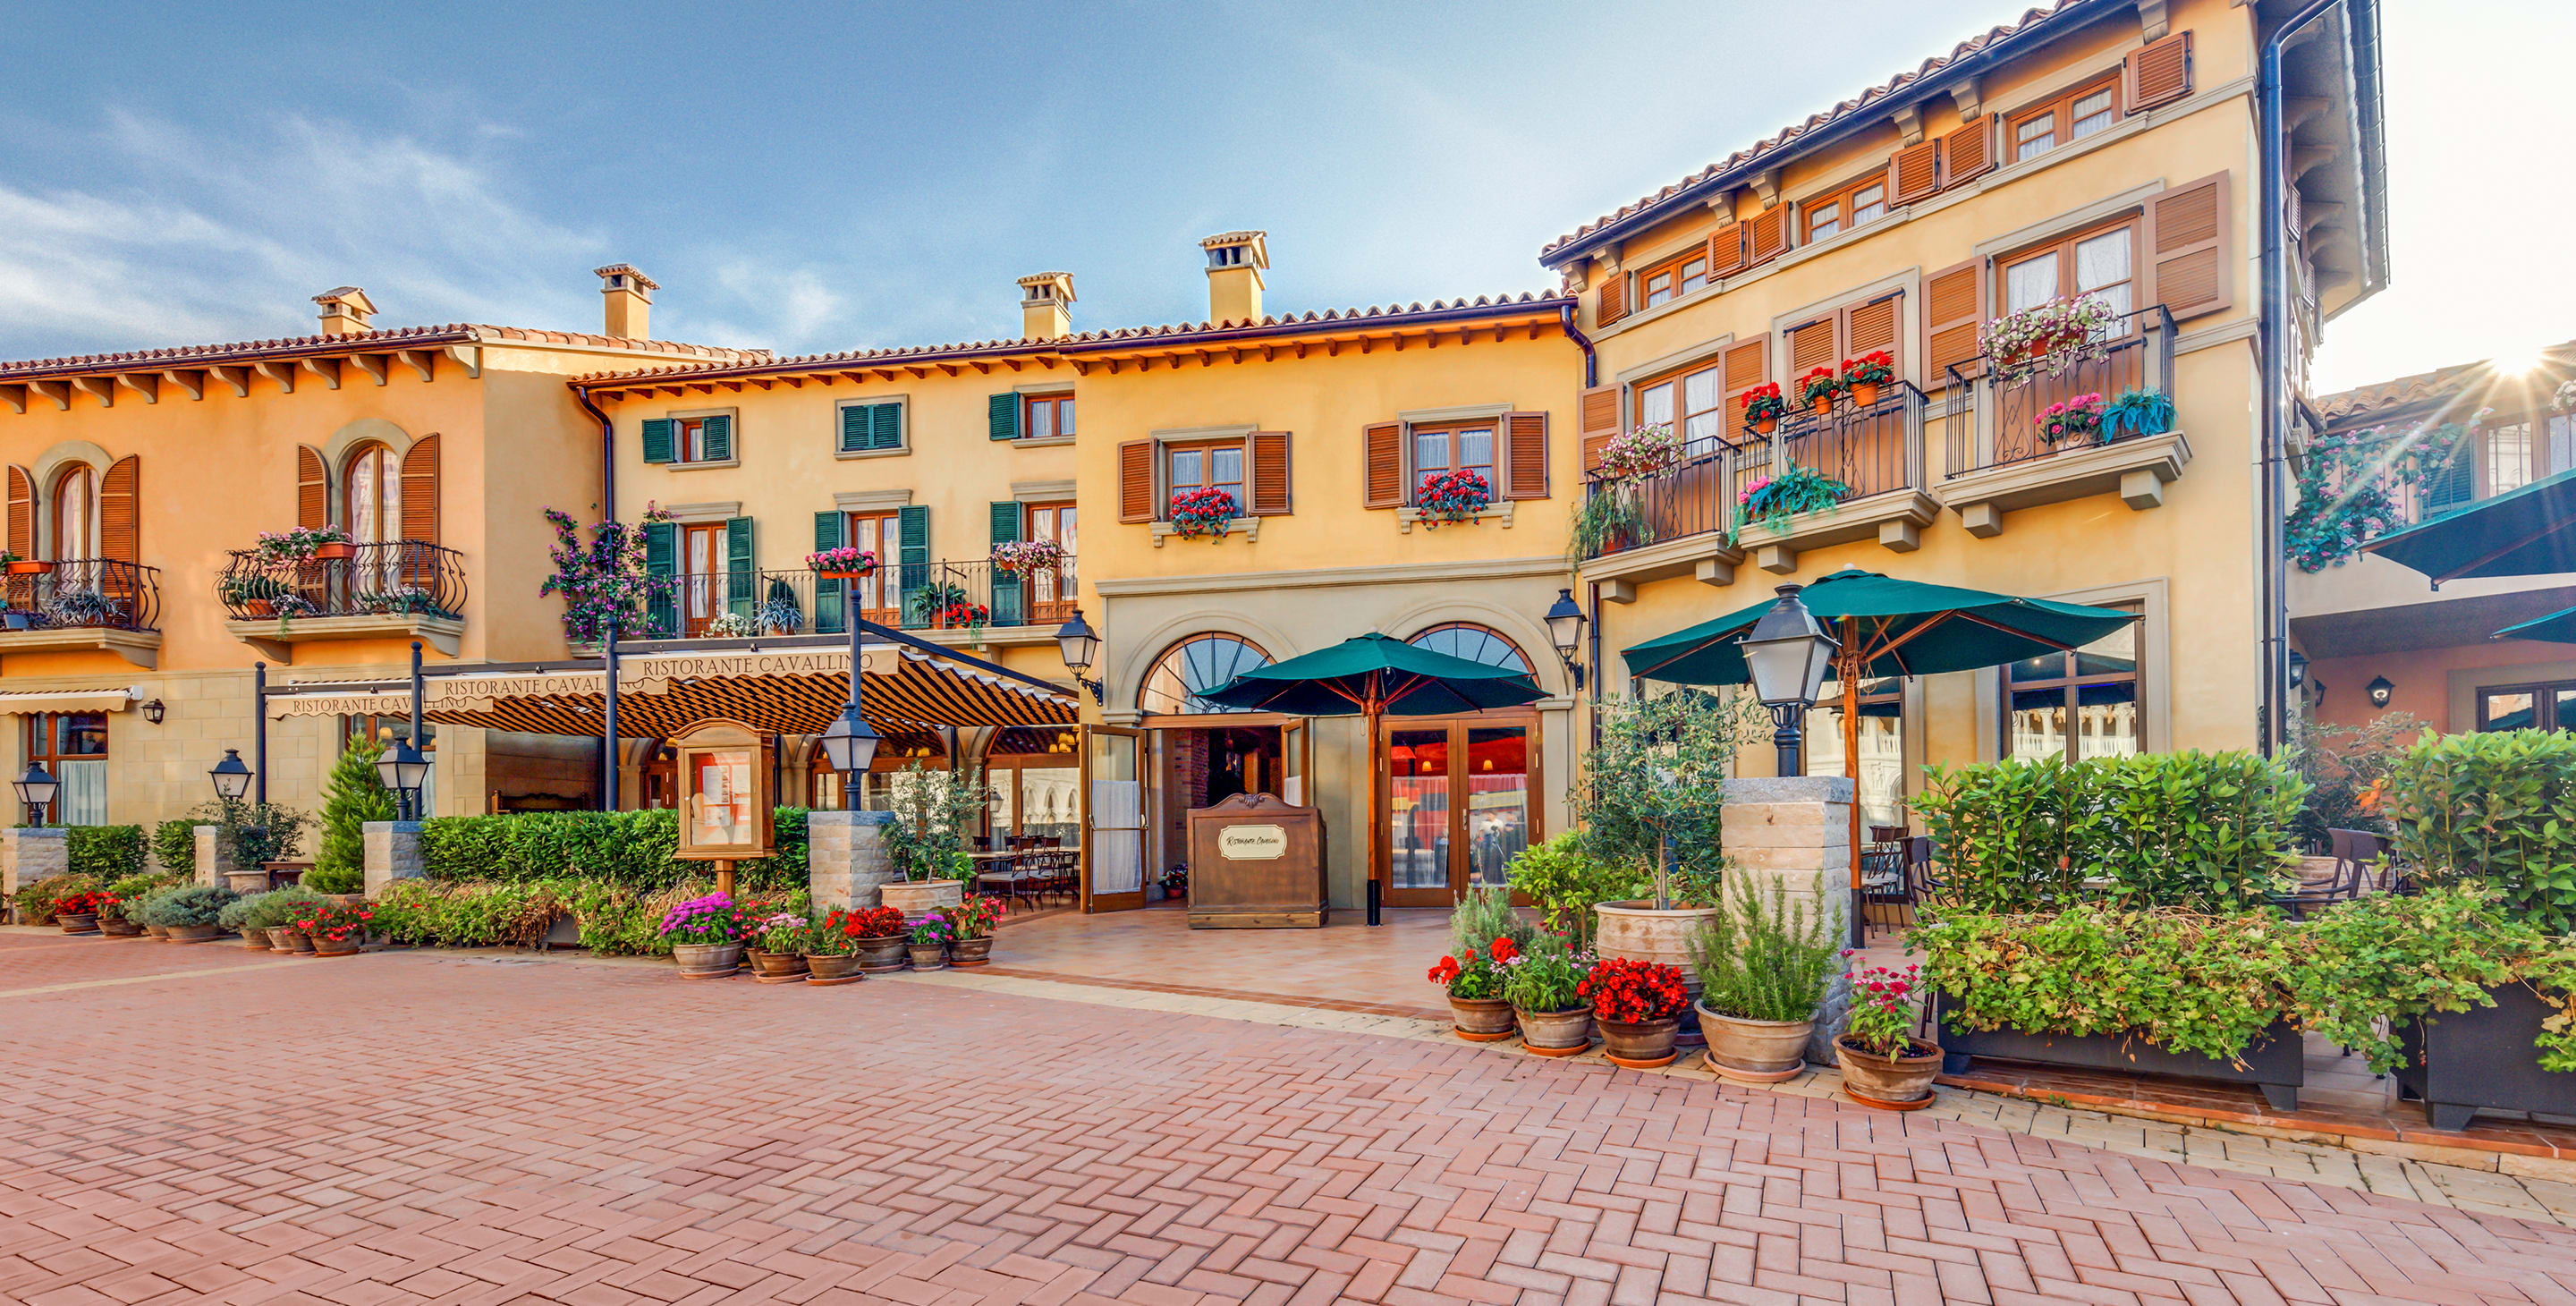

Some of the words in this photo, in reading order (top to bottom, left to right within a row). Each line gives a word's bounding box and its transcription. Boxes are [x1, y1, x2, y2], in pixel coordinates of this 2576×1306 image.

[643, 657, 752, 675] RISTORANTE
[445, 678, 540, 695] RISTORANTE
[293, 699, 377, 712] RISTORANTE
